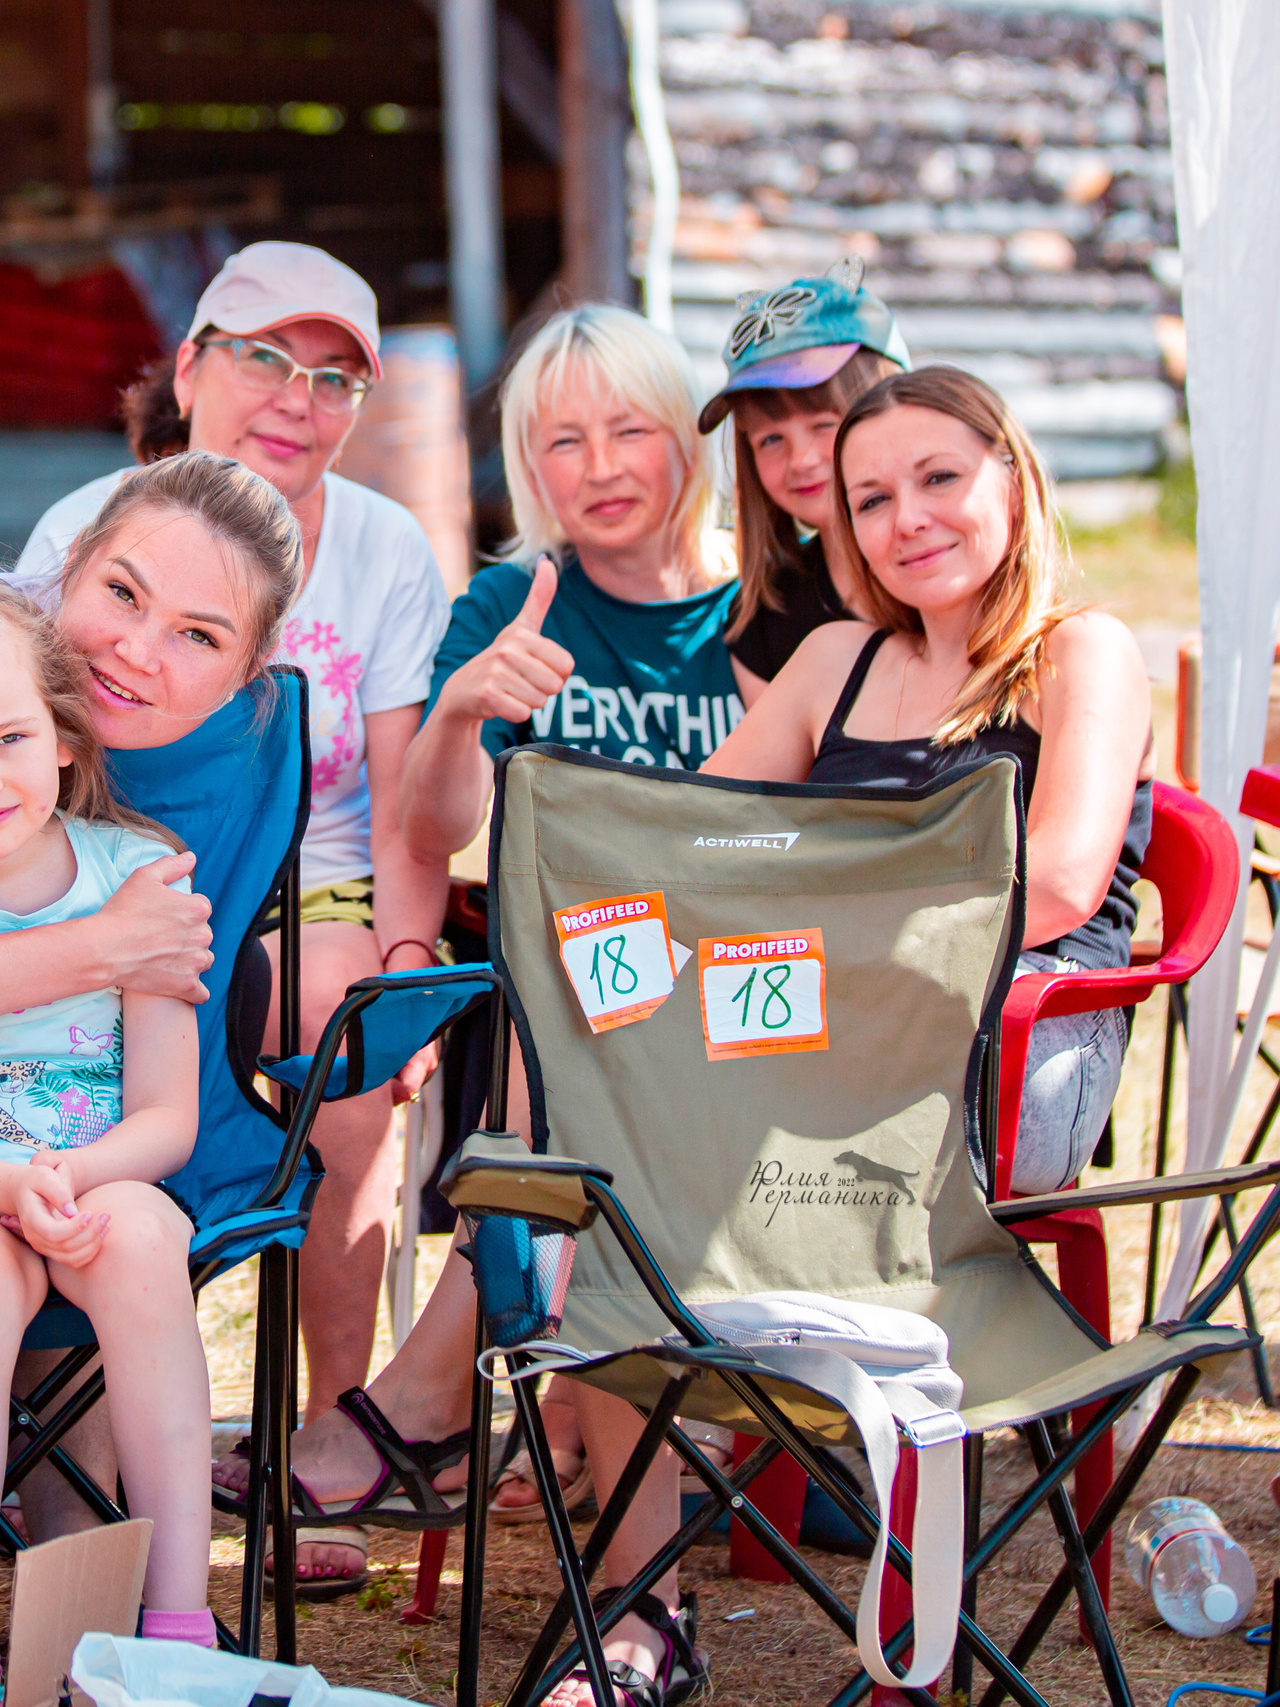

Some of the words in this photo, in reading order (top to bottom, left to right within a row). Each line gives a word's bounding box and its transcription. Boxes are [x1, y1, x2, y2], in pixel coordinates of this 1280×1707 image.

[693, 835, 783, 850] ACTIWELL
[560, 900, 650, 933] PROFIFEED
[712, 937, 810, 960] PROFIFEED
[589, 934, 639, 1006] 18
[731, 963, 792, 1030] 18
